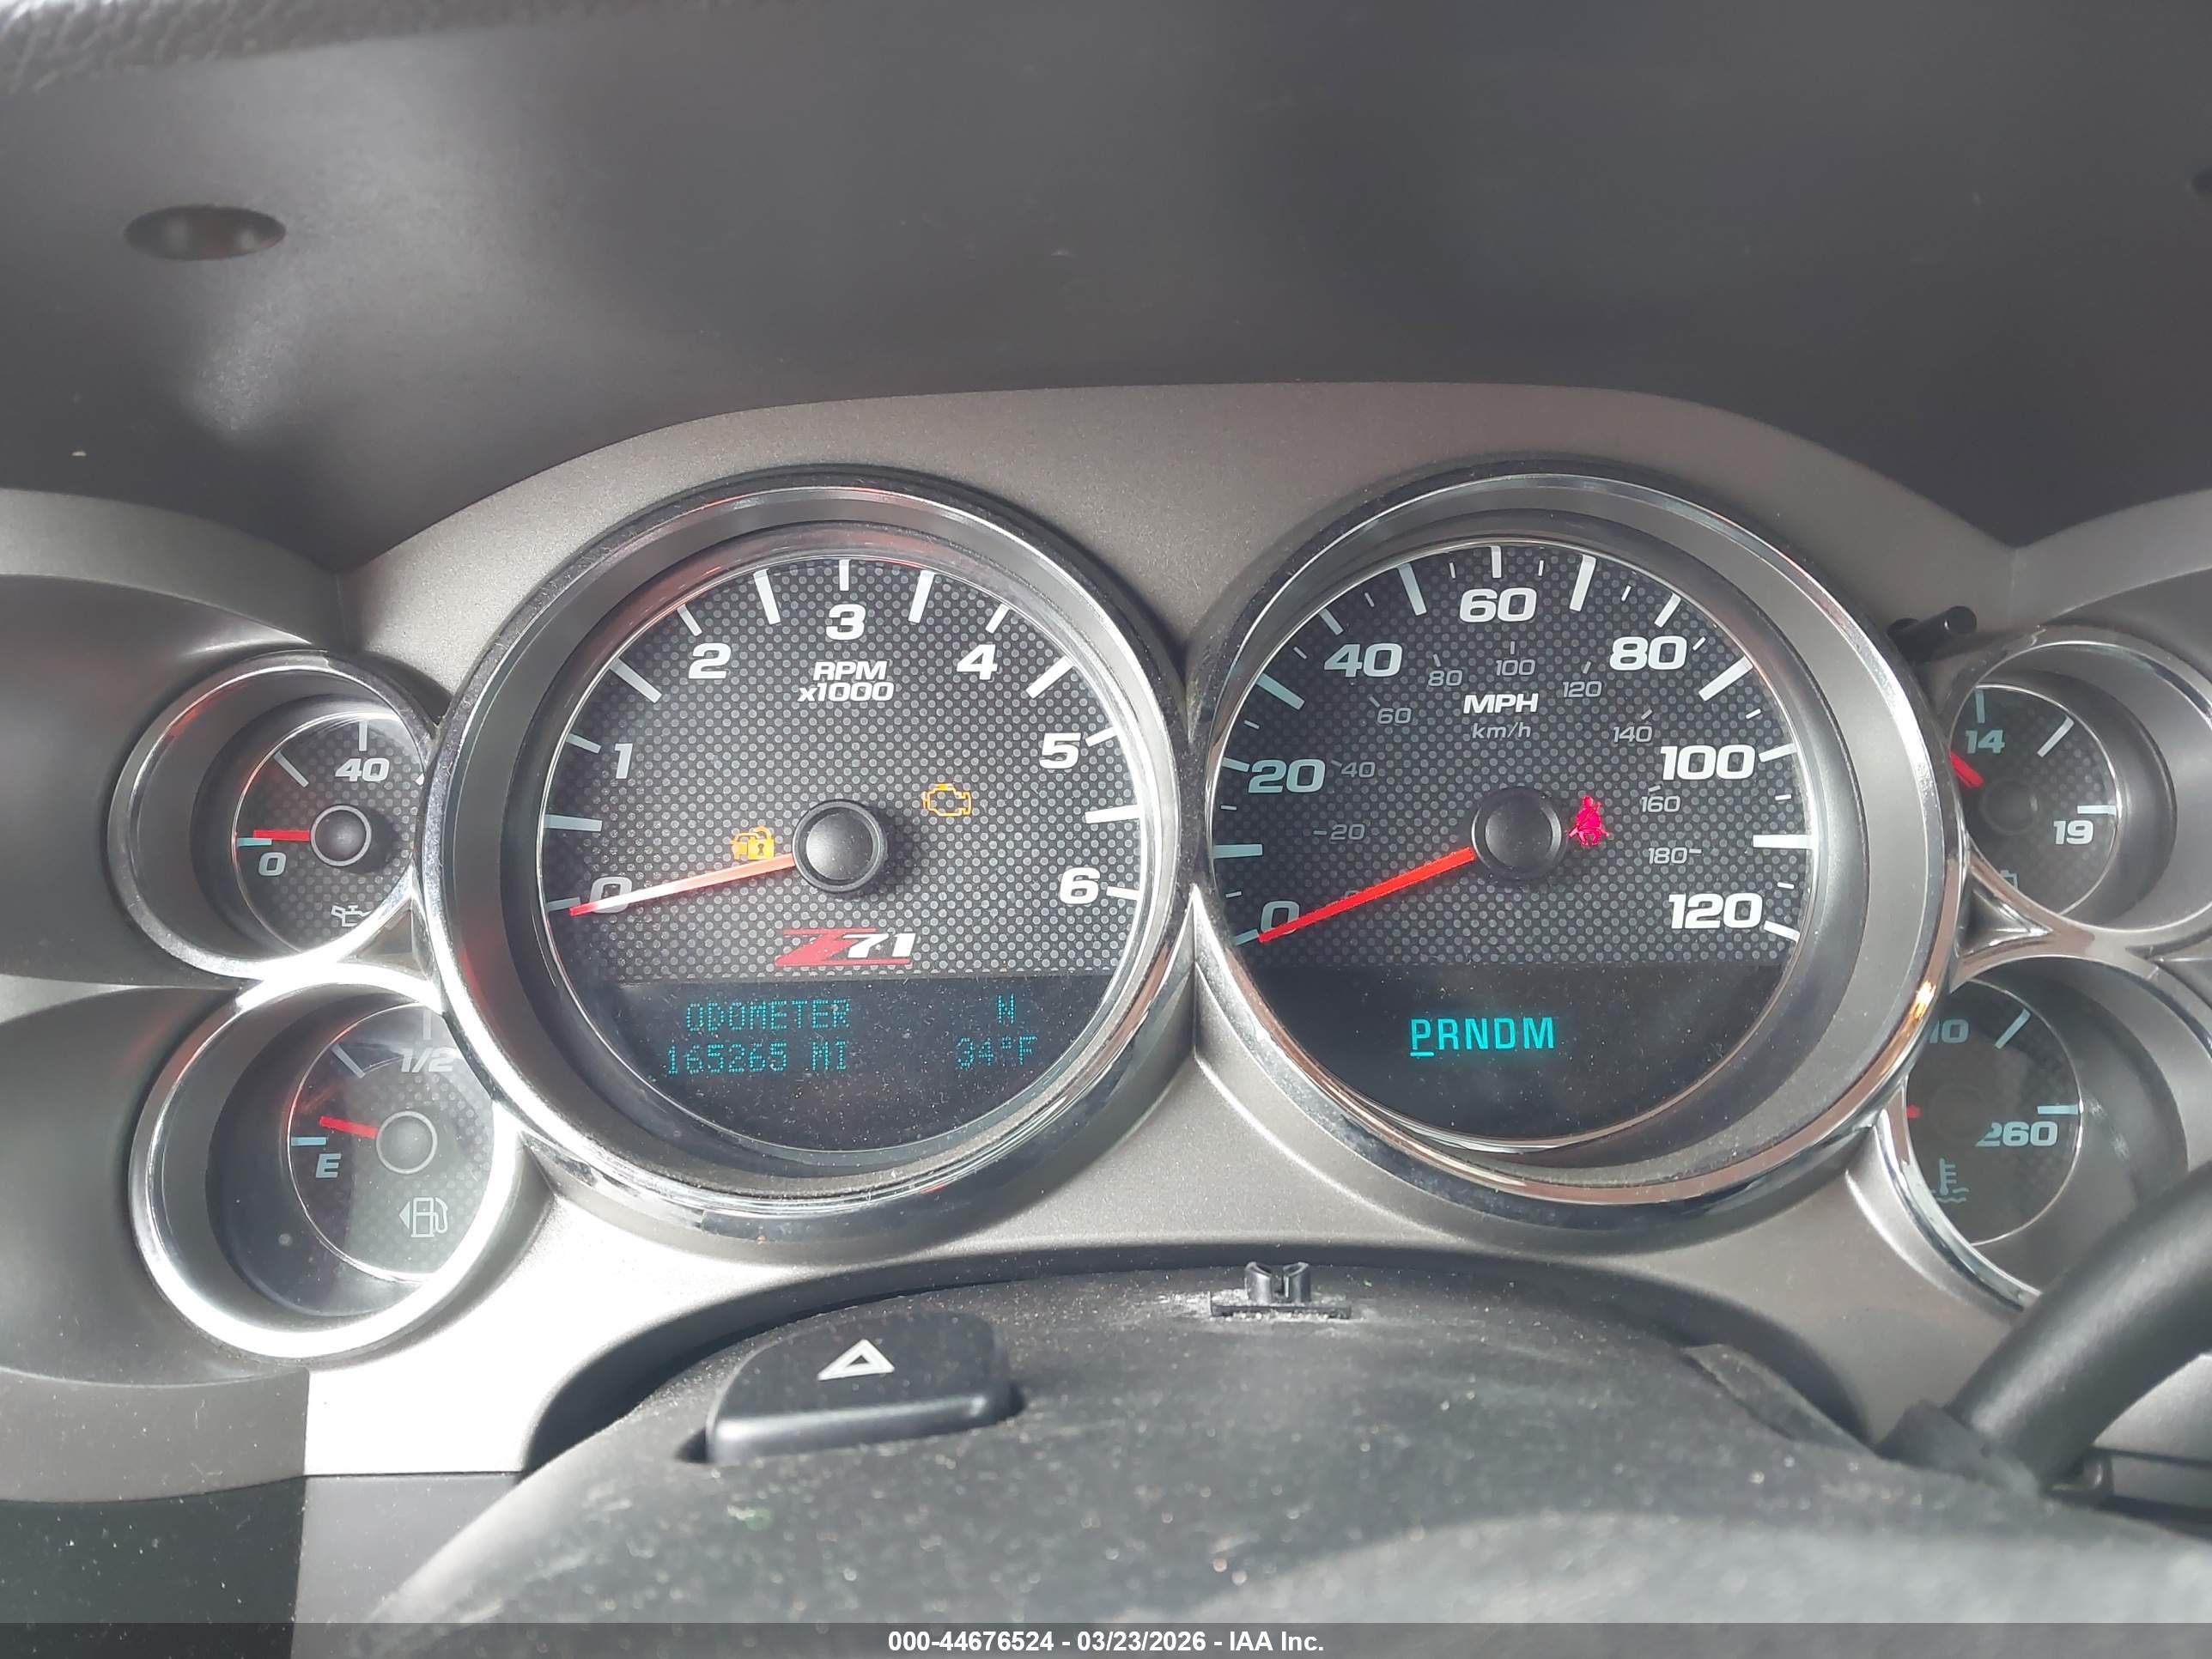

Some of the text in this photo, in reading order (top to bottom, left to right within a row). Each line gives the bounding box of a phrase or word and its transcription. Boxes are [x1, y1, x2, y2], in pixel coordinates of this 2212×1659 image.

[1459, 586, 1536, 623] 60
[826, 604, 866, 640] 3
[688, 642, 732, 679] 2
[957, 644, 997, 679] 4
[1324, 642, 1403, 678] 40
[1609, 635, 1686, 671] 80
[812, 660, 887, 681] RPM
[1427, 668, 1462, 687] 80
[1495, 659, 1535, 677] 100
[797, 681, 895, 702] x1000
[1562, 680, 1602, 698] 120
[1376, 706, 1412, 725] 60
[1462, 693, 1538, 714] MPH
[1472, 722, 1532, 741] km/h
[1613, 726, 1653, 744] 140
[1966, 730, 2005, 754] 14
[614, 743, 634, 779] 1
[1039, 732, 1080, 769] 5
[1660, 744, 1755, 781] 100
[335, 757, 390, 781] 40
[1248, 758, 1325, 794] 20
[1340, 762, 1376, 780] 40
[1640, 794, 1680, 813] 160
[1329, 823, 1365, 841] 20
[2053, 819, 2094, 845] 19
[258, 852, 287, 877] 0
[1648, 847, 1686, 865] 180
[590, 876, 631, 914] 0
[1059, 867, 1101, 905] 6
[1260, 900, 1300, 935] 0
[1668, 892, 1763, 930] 120
[775, 927, 916, 968] Z71
[686, 999, 851, 1031] ODOMETER
[1410, 1017, 1555, 1057] PRNDM
[1929, 1018, 1969, 1044] 10
[399, 1047, 455, 1073] 1/2
[665, 1041, 848, 1075] 165265 MI
[957, 1035, 1037, 1070] 34°F
[1975, 1121, 2058, 1147] 260
[315, 1153, 342, 1178] E
